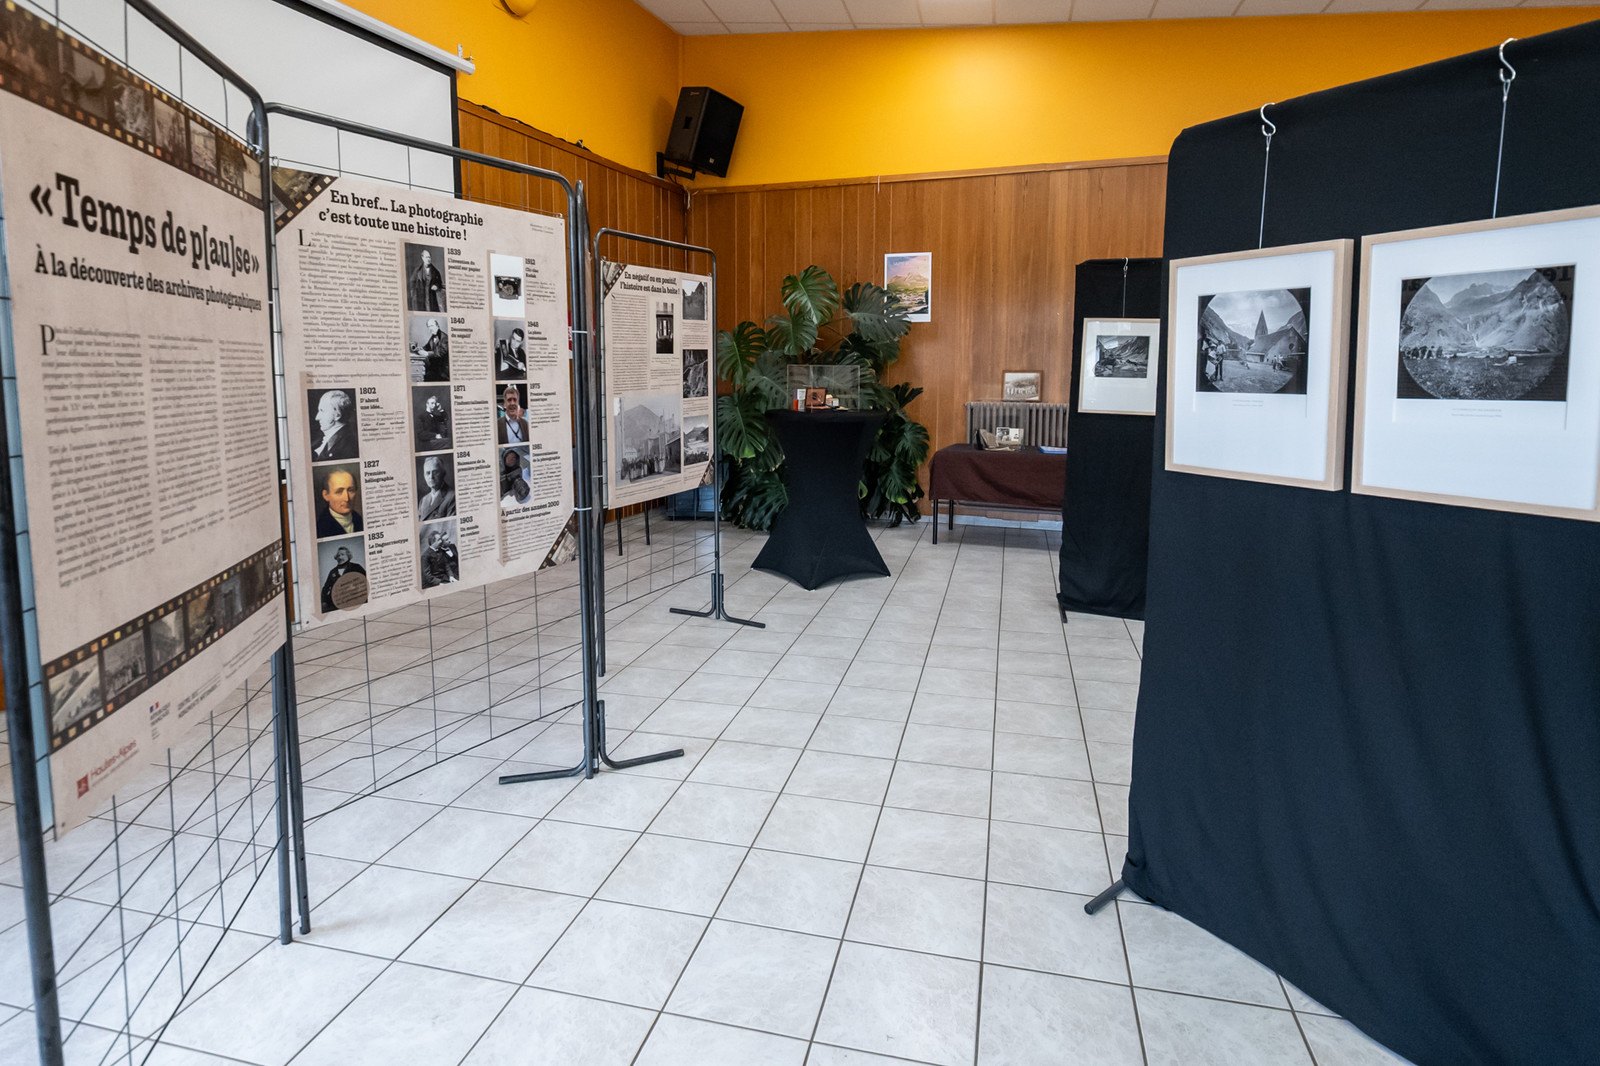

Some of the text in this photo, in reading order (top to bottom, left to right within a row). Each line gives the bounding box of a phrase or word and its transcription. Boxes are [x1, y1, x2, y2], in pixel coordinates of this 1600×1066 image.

[330, 189, 350, 205] En
[390, 199, 407, 214] La
[408, 203, 484, 227] photographie
[162, 210, 187, 256] de
[354, 214, 390, 230] toute
[391, 222, 415, 234] une
[416, 222, 462, 241] histoire
[463, 229, 467, 241] !
[35, 243, 262, 312] À la découverte des archives photographiques
[624, 272, 631, 280] En
[364, 460, 380, 468] 1827
[368, 532, 384, 541] 1835
